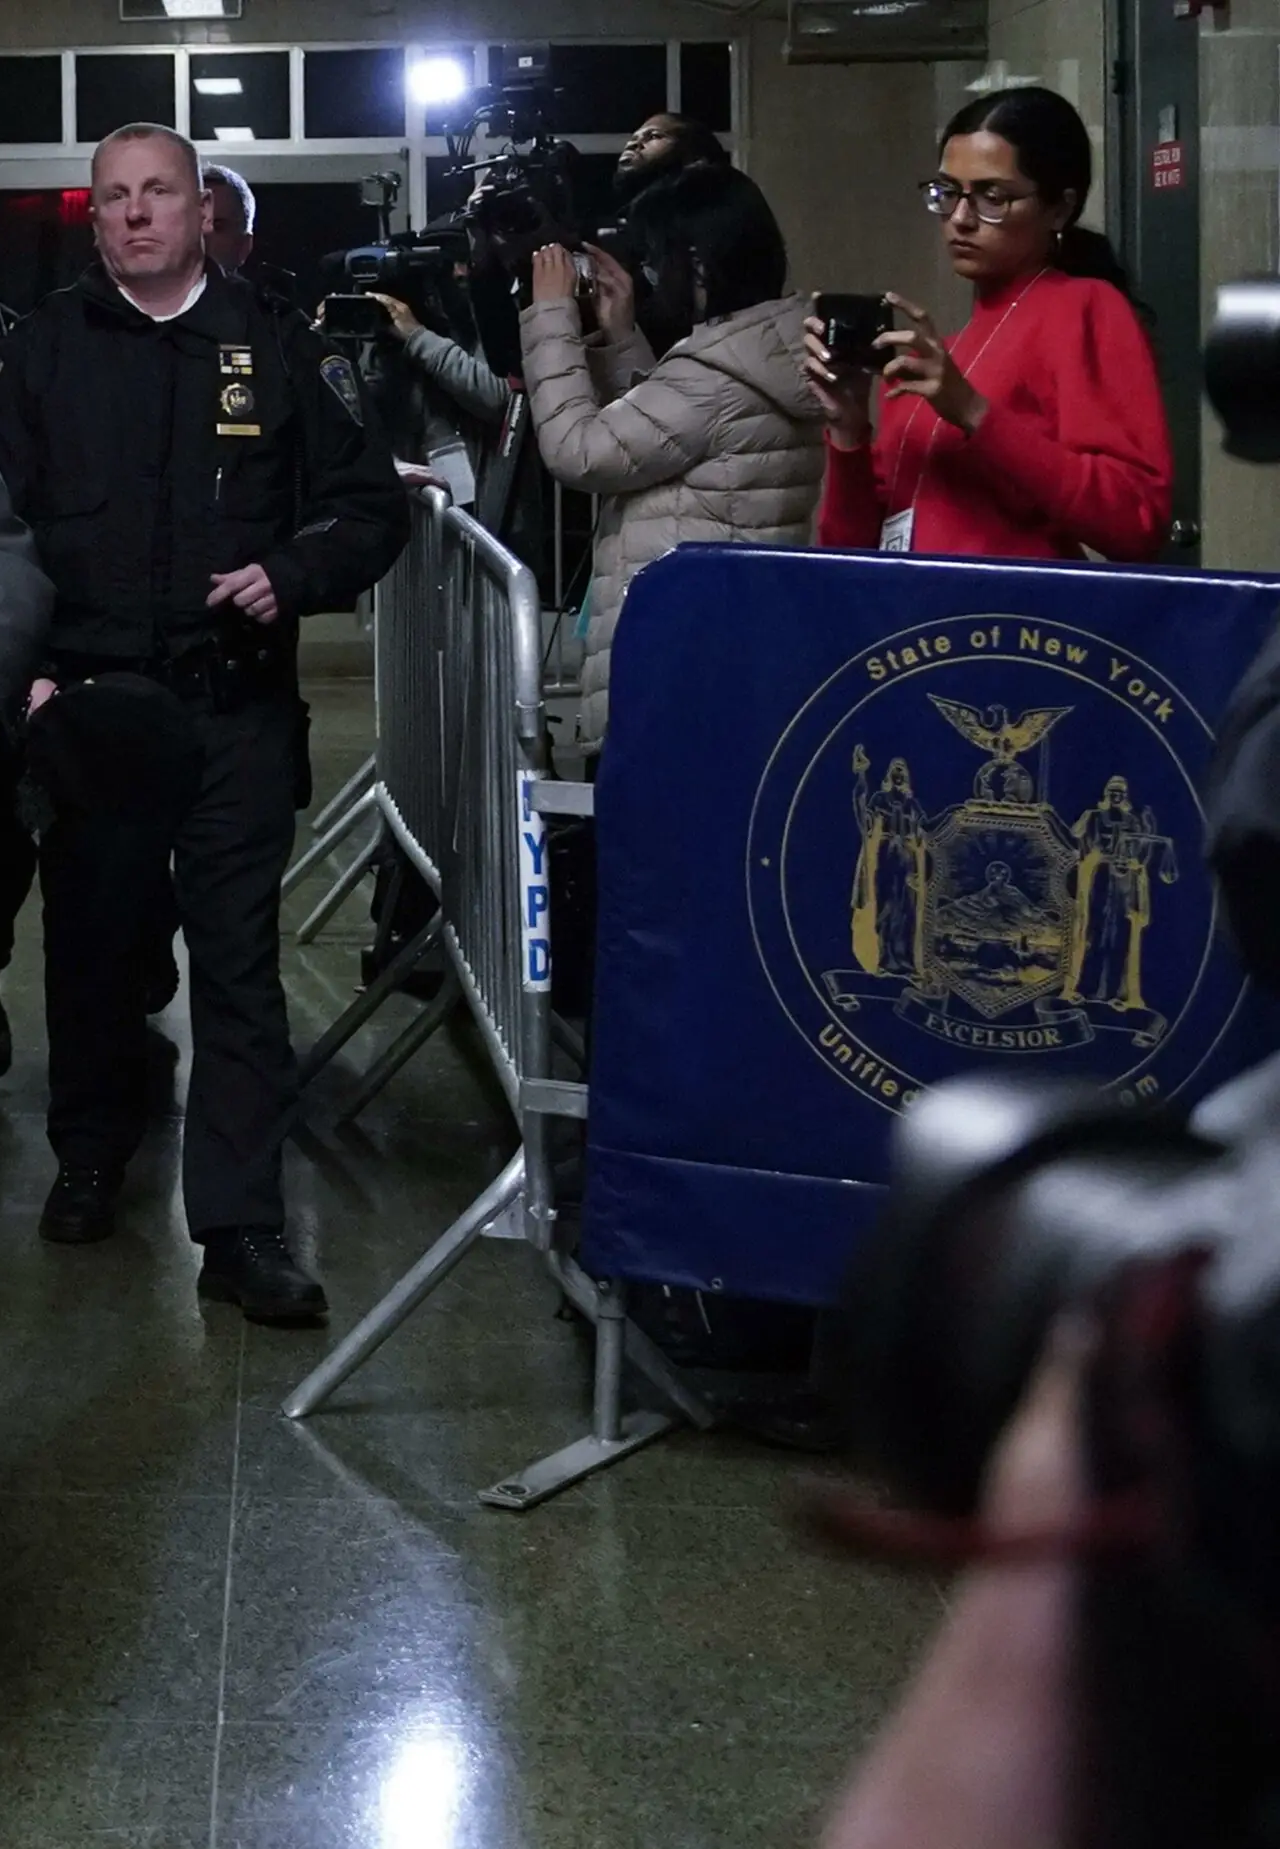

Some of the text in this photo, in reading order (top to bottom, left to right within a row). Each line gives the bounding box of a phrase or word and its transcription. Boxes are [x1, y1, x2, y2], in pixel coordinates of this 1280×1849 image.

[866, 625, 1175, 724] State of New York
[925, 1012, 1063, 1049] EXCELSIOR
